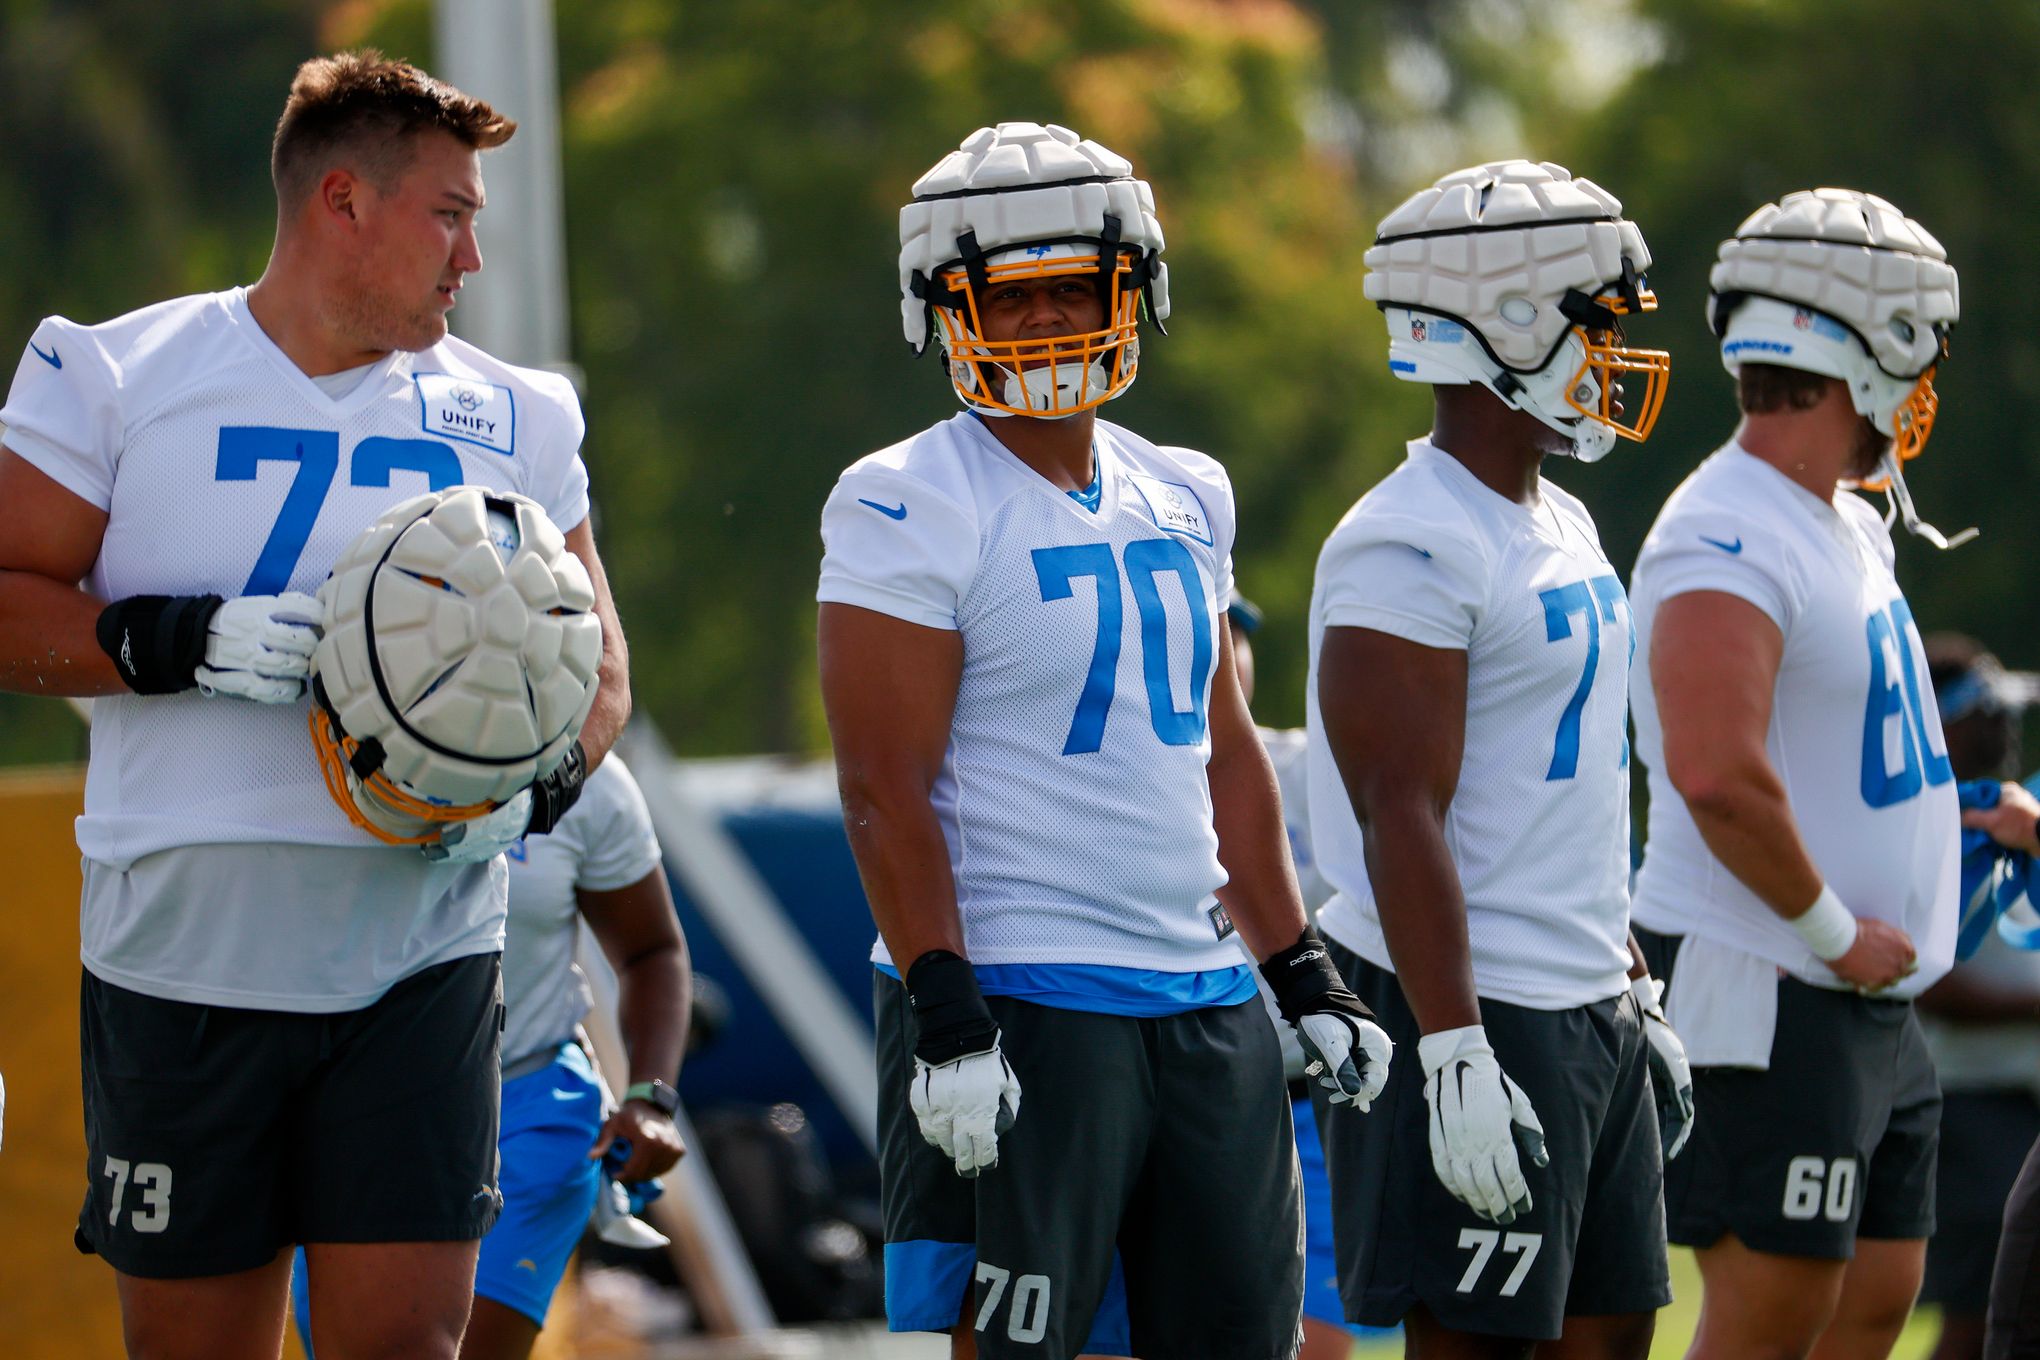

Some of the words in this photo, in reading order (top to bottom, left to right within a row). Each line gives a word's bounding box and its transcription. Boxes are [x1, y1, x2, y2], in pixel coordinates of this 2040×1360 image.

[442, 408, 496, 434] UNIFY
[1163, 508, 1199, 528] UNIFY
[1030, 538, 1213, 756] 70
[104, 1154, 173, 1234] 73
[1782, 1154, 1857, 1222] 60
[1456, 1227, 1543, 1298] 77
[974, 1260, 1051, 1344] 70
